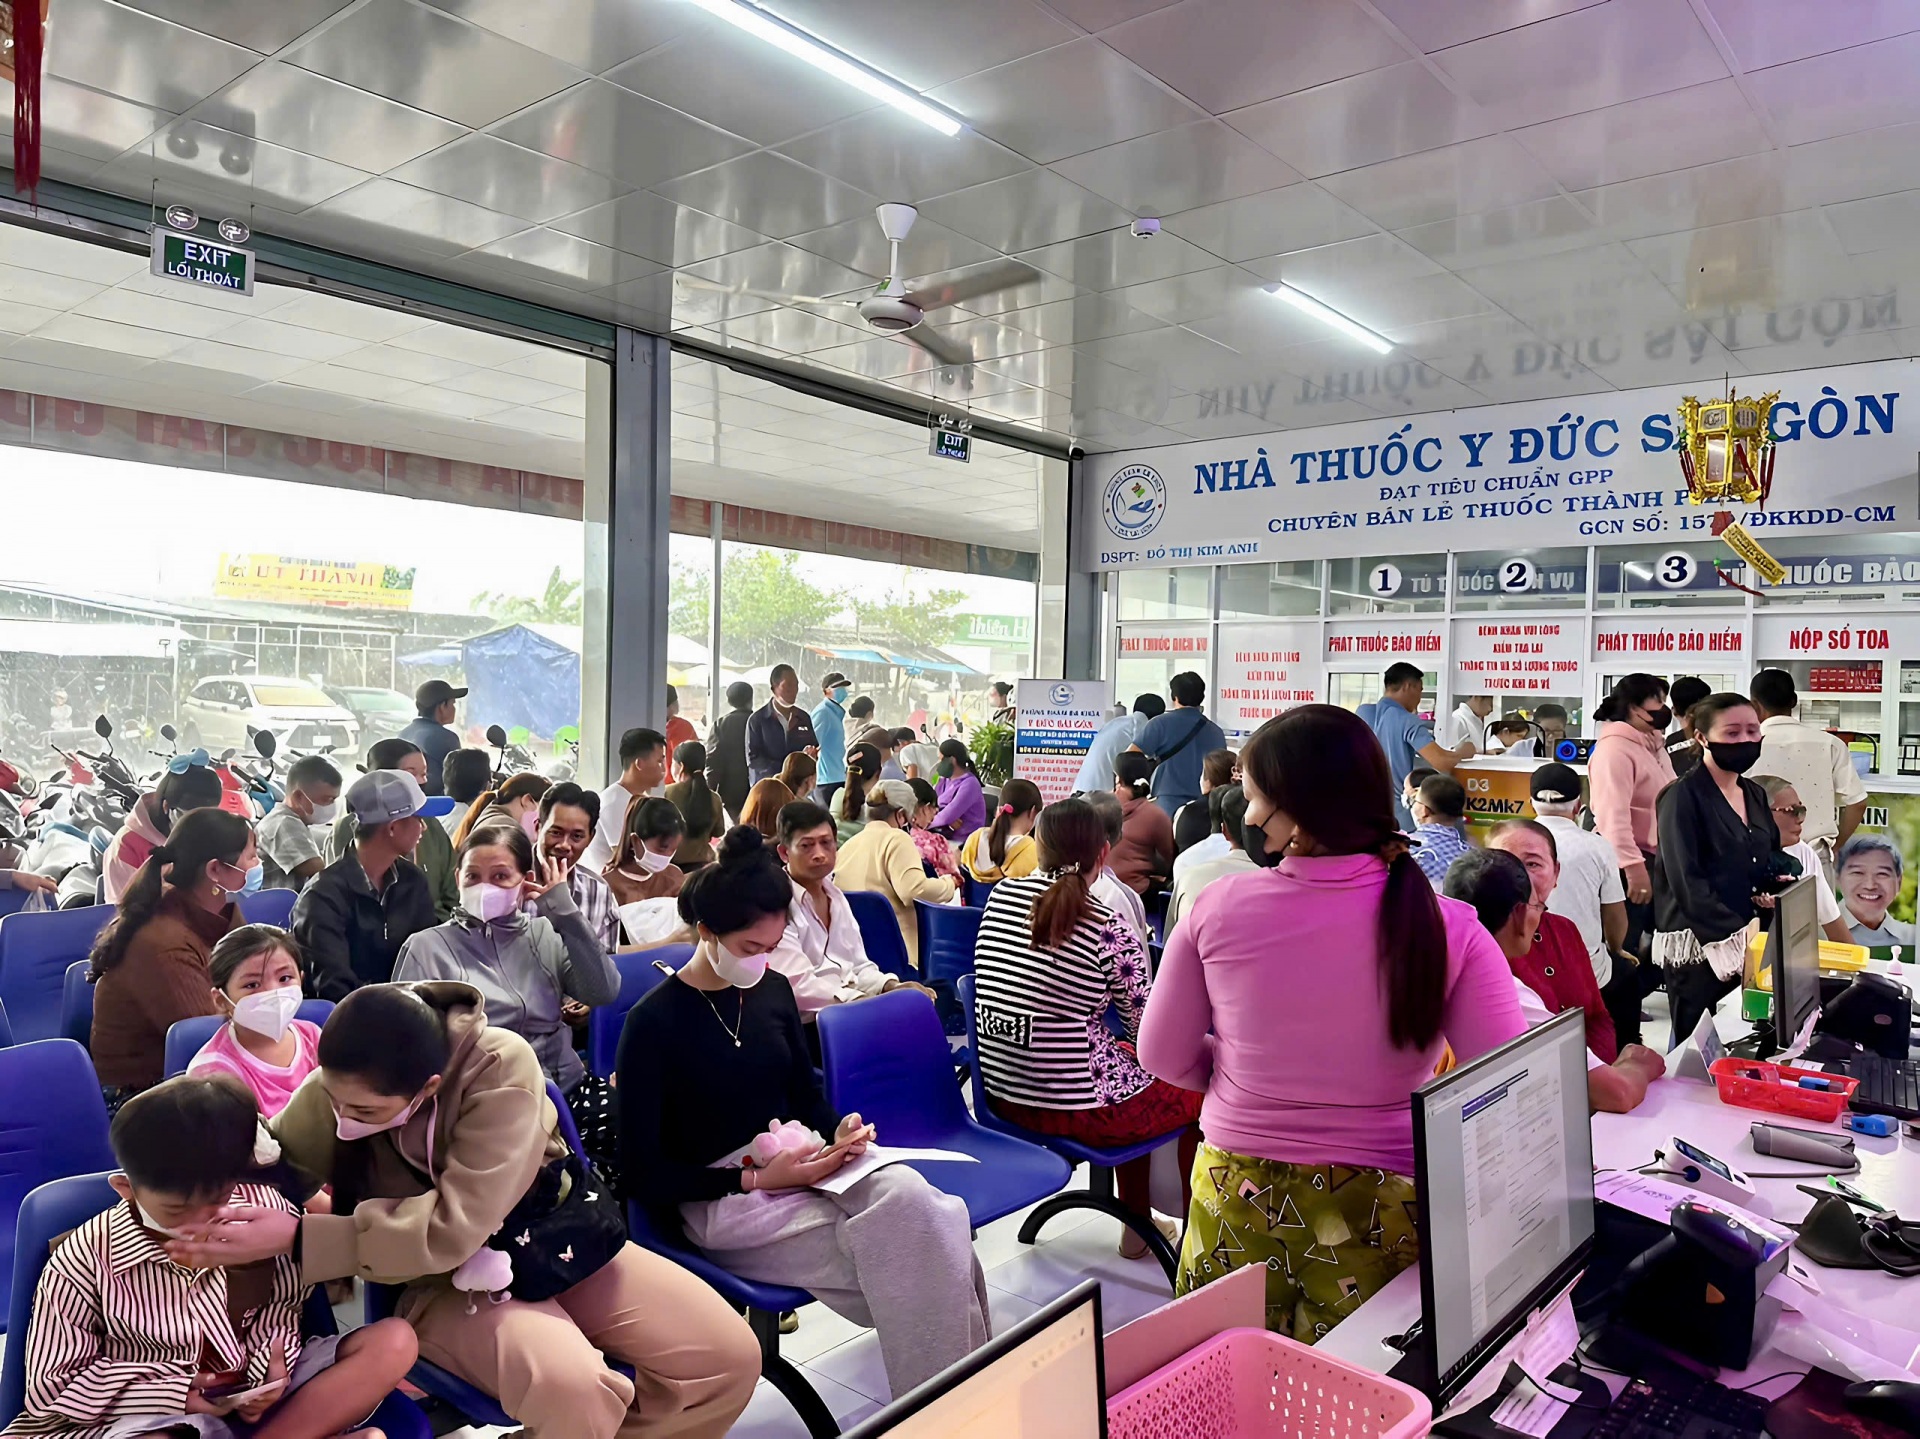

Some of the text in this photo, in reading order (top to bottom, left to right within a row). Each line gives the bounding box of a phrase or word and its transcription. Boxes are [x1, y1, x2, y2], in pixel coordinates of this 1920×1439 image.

[184, 242, 231, 267] EXIT
[195, 268, 240, 288] THOÁT
[1194, 447, 1276, 494] NHÀ
[1290, 423, 1442, 484] THUỐC
[1459, 432, 1493, 467] Y
[1508, 412, 1619, 464] ĐỨC
[1769, 386, 1899, 443] GÒN
[1379, 466, 1614, 502] ĐẠT TIÊU CHUẨN GPP
[1268, 511, 1357, 532] CHUYÊN
[1366, 506, 1414, 526] BÁN
[1422, 500, 1453, 521] LẺ
[1463, 492, 1553, 518] THUỐC
[1562, 489, 1663, 512] THÀNH
[1579, 519, 1624, 535] GCN
[1632, 510, 1668, 532] SỐ:
[1101, 551, 1140, 563] DSPT:
[1197, 545, 1223, 556] KIM
[1227, 542, 1258, 555] ANH
[1377, 568, 1392, 591] 1
[1506, 562, 1527, 588] 2
[1550, 571, 1574, 591] VỤ
[1662, 555, 1688, 583] 3
[1356, 631, 1389, 652] THUỐC
[1598, 626, 1742, 651] PHÁT THUỐC BẢO HIỂM
[1789, 627, 1823, 653] NỘP
[1856, 629, 1890, 650] TOA
[1467, 778, 1489, 792] D3
